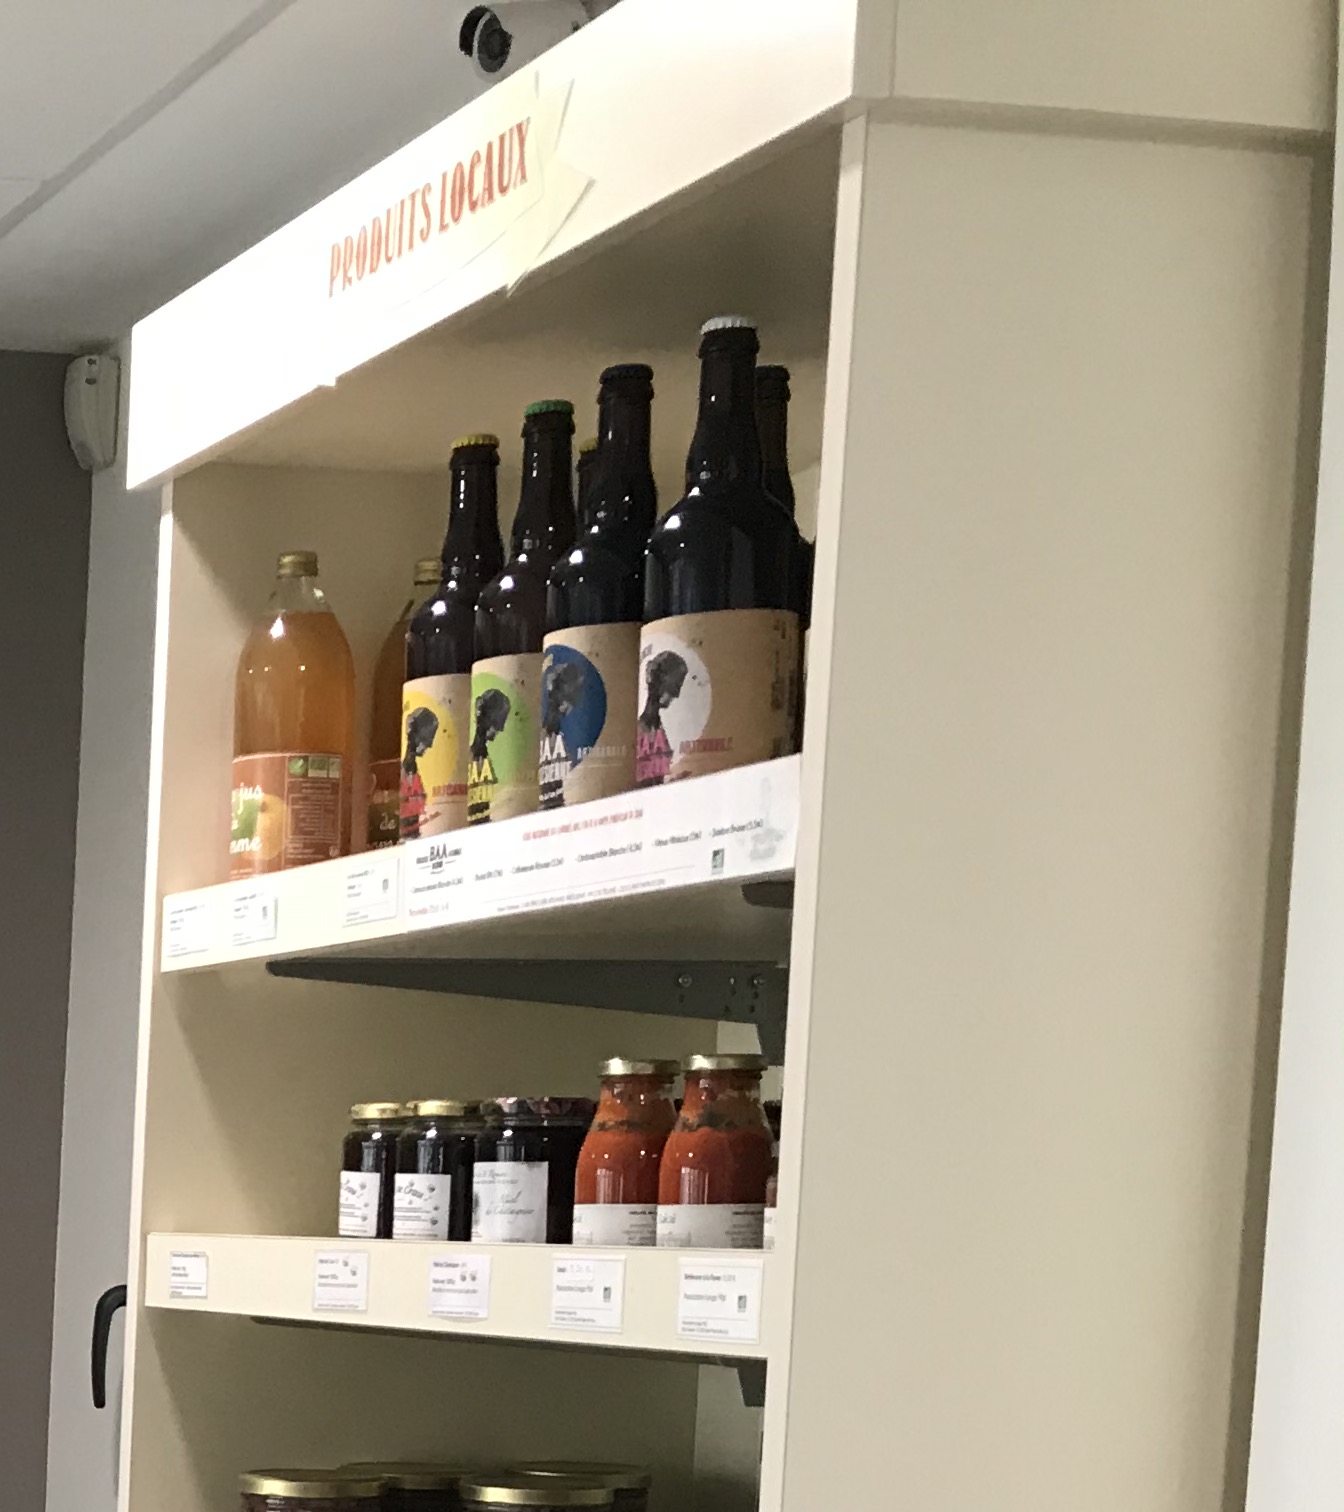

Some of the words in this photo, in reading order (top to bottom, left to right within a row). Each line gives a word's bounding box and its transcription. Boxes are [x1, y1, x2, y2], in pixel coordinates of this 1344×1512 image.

[329, 183, 432, 299] PRODUITS
[439, 117, 530, 235] LOCAUX
[540, 734, 566, 763] AA
[468, 759, 493, 783] AA
